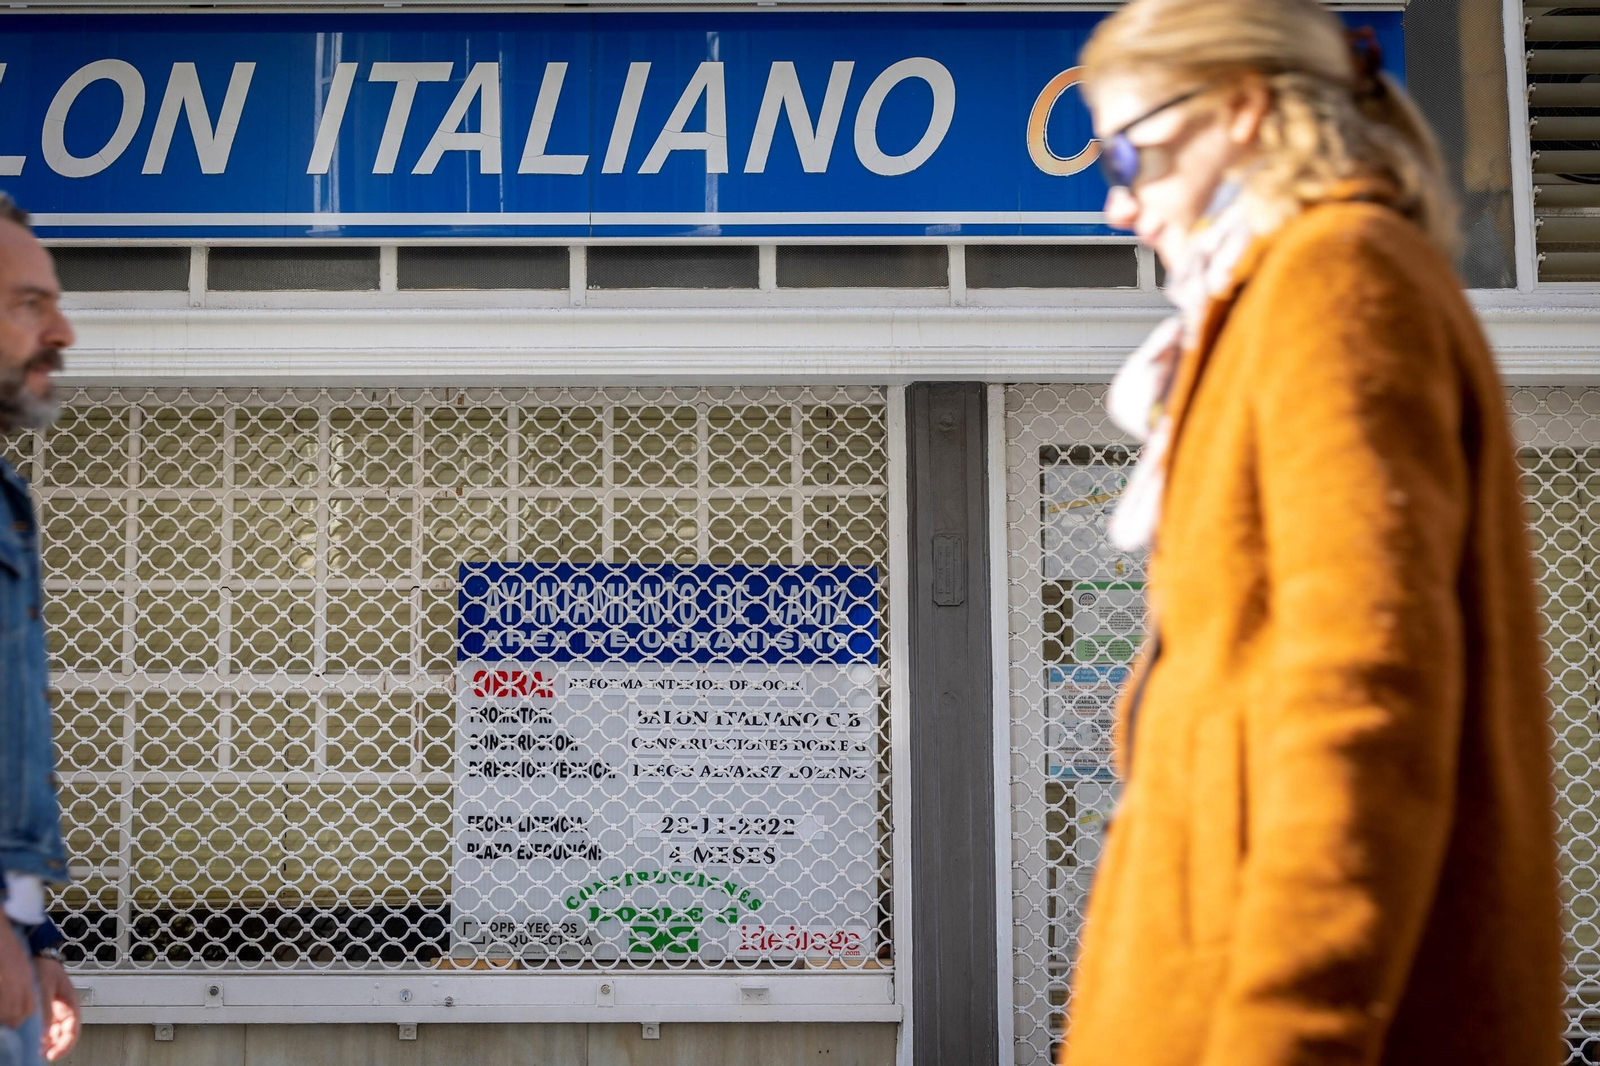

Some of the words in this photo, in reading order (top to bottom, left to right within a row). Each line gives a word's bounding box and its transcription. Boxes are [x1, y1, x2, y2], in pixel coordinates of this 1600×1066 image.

[306, 57, 956, 176] ITALIANO
[483, 582, 697, 624] AYUNTAMIENTO
[716, 584, 750, 624] DE
[769, 585, 848, 626] CADIZ
[482, 630, 571, 647] AREA
[585, 631, 628, 647] DE
[642, 631, 848, 650] URBANISMO
[473, 670, 553, 698] OBRA:
[715, 711, 819, 727] ITALIANO
[631, 737, 788, 751] CONSTRUCCIONES
[794, 740, 849, 752] DOBLE
[467, 816, 513, 832] FECHA
[467, 843, 512, 860] PLAZO
[669, 847, 682, 863] 4
[693, 847, 776, 864] MESES
[566, 871, 762, 911] CONSTRUCCIONES
[589, 907, 704, 922] DOBLE
[715, 907, 738, 924] G
[475, 922, 577, 934] OPRYECOS
